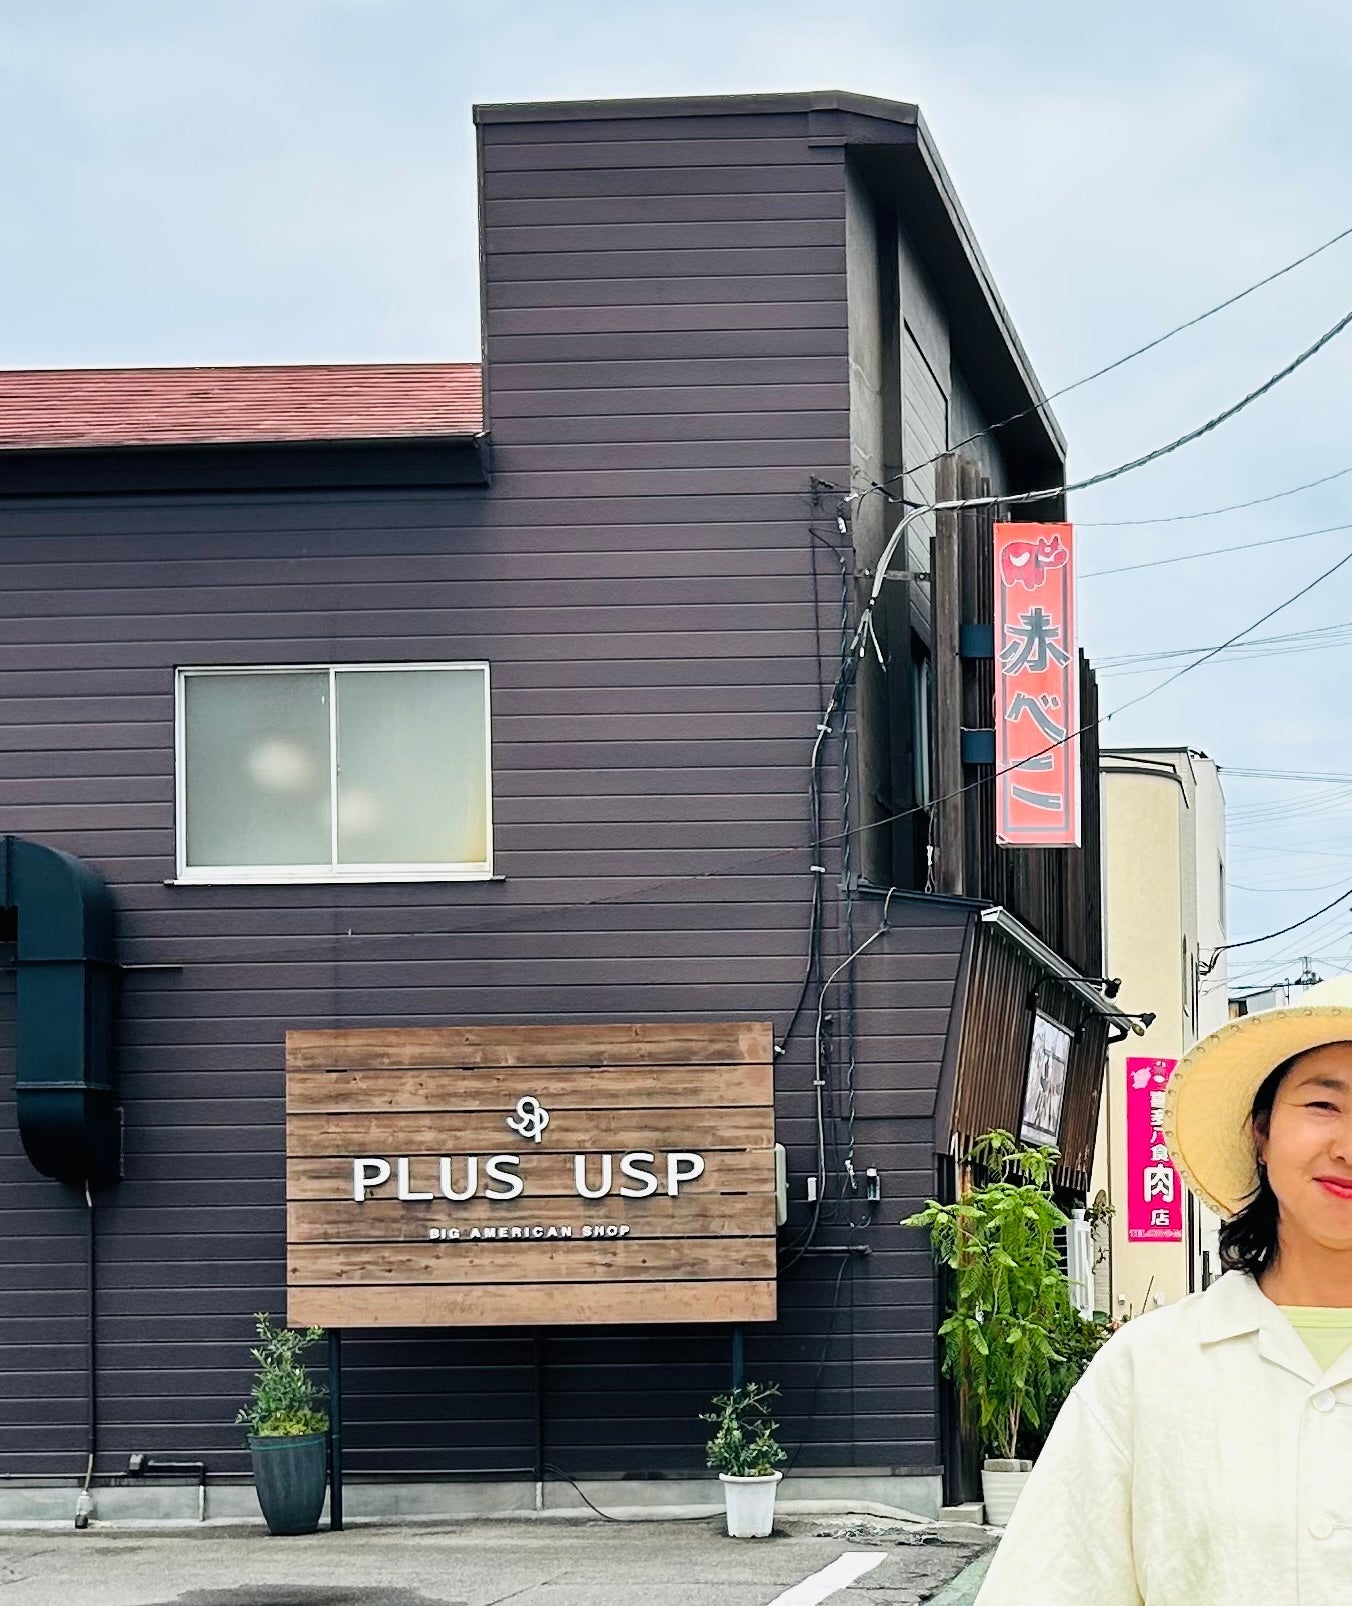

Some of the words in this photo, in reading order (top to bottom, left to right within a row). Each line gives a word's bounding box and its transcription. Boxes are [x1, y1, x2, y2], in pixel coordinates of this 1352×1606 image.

[999, 607, 1072, 812] 赤べこ
[353, 1155, 525, 1202] PLUS
[574, 1152, 705, 1199] USP
[429, 1227, 460, 1240] BIG
[470, 1226, 573, 1239] AMERICAN
[582, 1225, 631, 1238] SHOP
